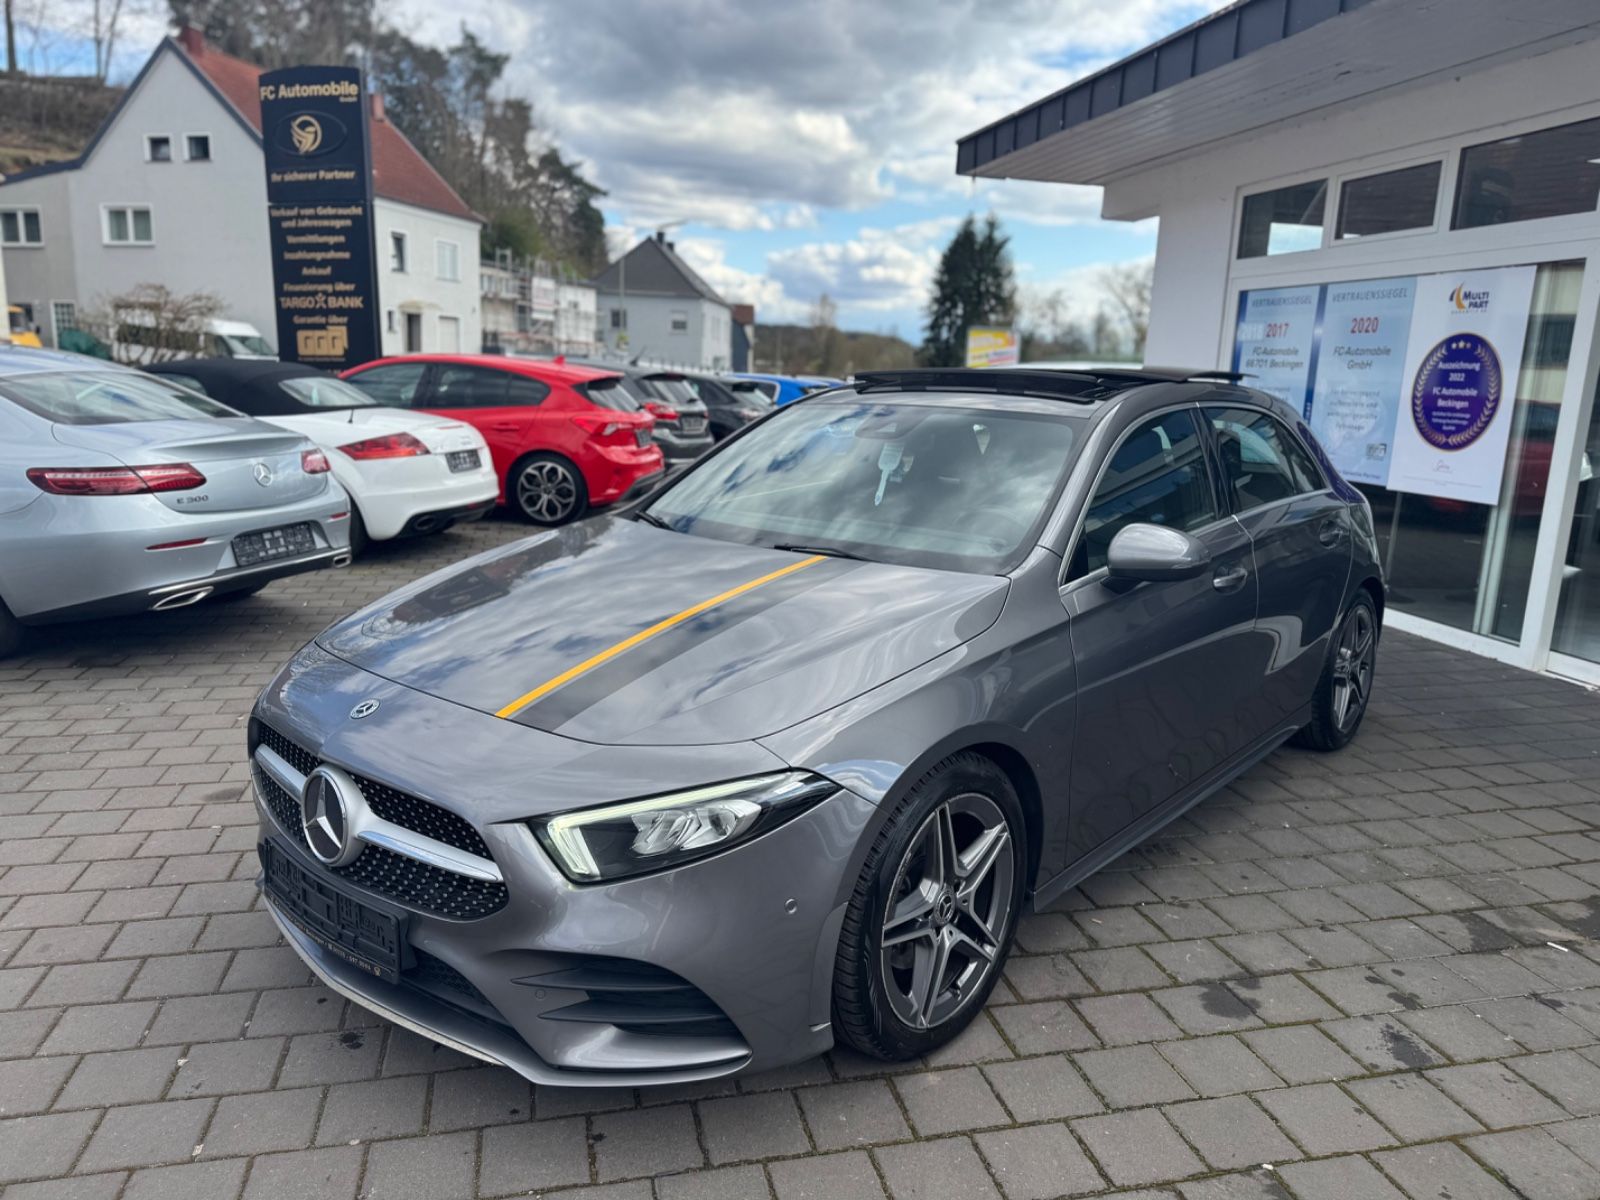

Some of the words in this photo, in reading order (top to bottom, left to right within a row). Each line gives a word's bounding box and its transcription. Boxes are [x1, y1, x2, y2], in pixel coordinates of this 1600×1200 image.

[260, 86, 275, 100] FC
[278, 81, 359, 98] Automobile
[284, 170, 317, 181] sicherer
[319, 169, 355, 180] Partner
[281, 218, 296, 228] und
[302, 266, 332, 275] Ankauf
[283, 282, 333, 293] Finanzierung
[334, 282, 355, 291] über
[1332, 287, 1407, 303] VERTRAUENSSIEGEL
[1463, 290, 1489, 301] MULTI
[1468, 300, 1489, 310] PART
[293, 315, 326, 324] Garantie
[328, 314, 348, 324] über
[1266, 323, 1289, 338] 2017
[1351, 317, 1379, 334] 2020
[1269, 360, 1303, 371] Beckingen
[1347, 360, 1373, 370] GmbH
[1438, 361, 1481, 372] Auszeichnung
[1442, 387, 1478, 398] Automobile
[1437, 399, 1470, 409] Beckingen
[186, 494, 209, 504] 300
